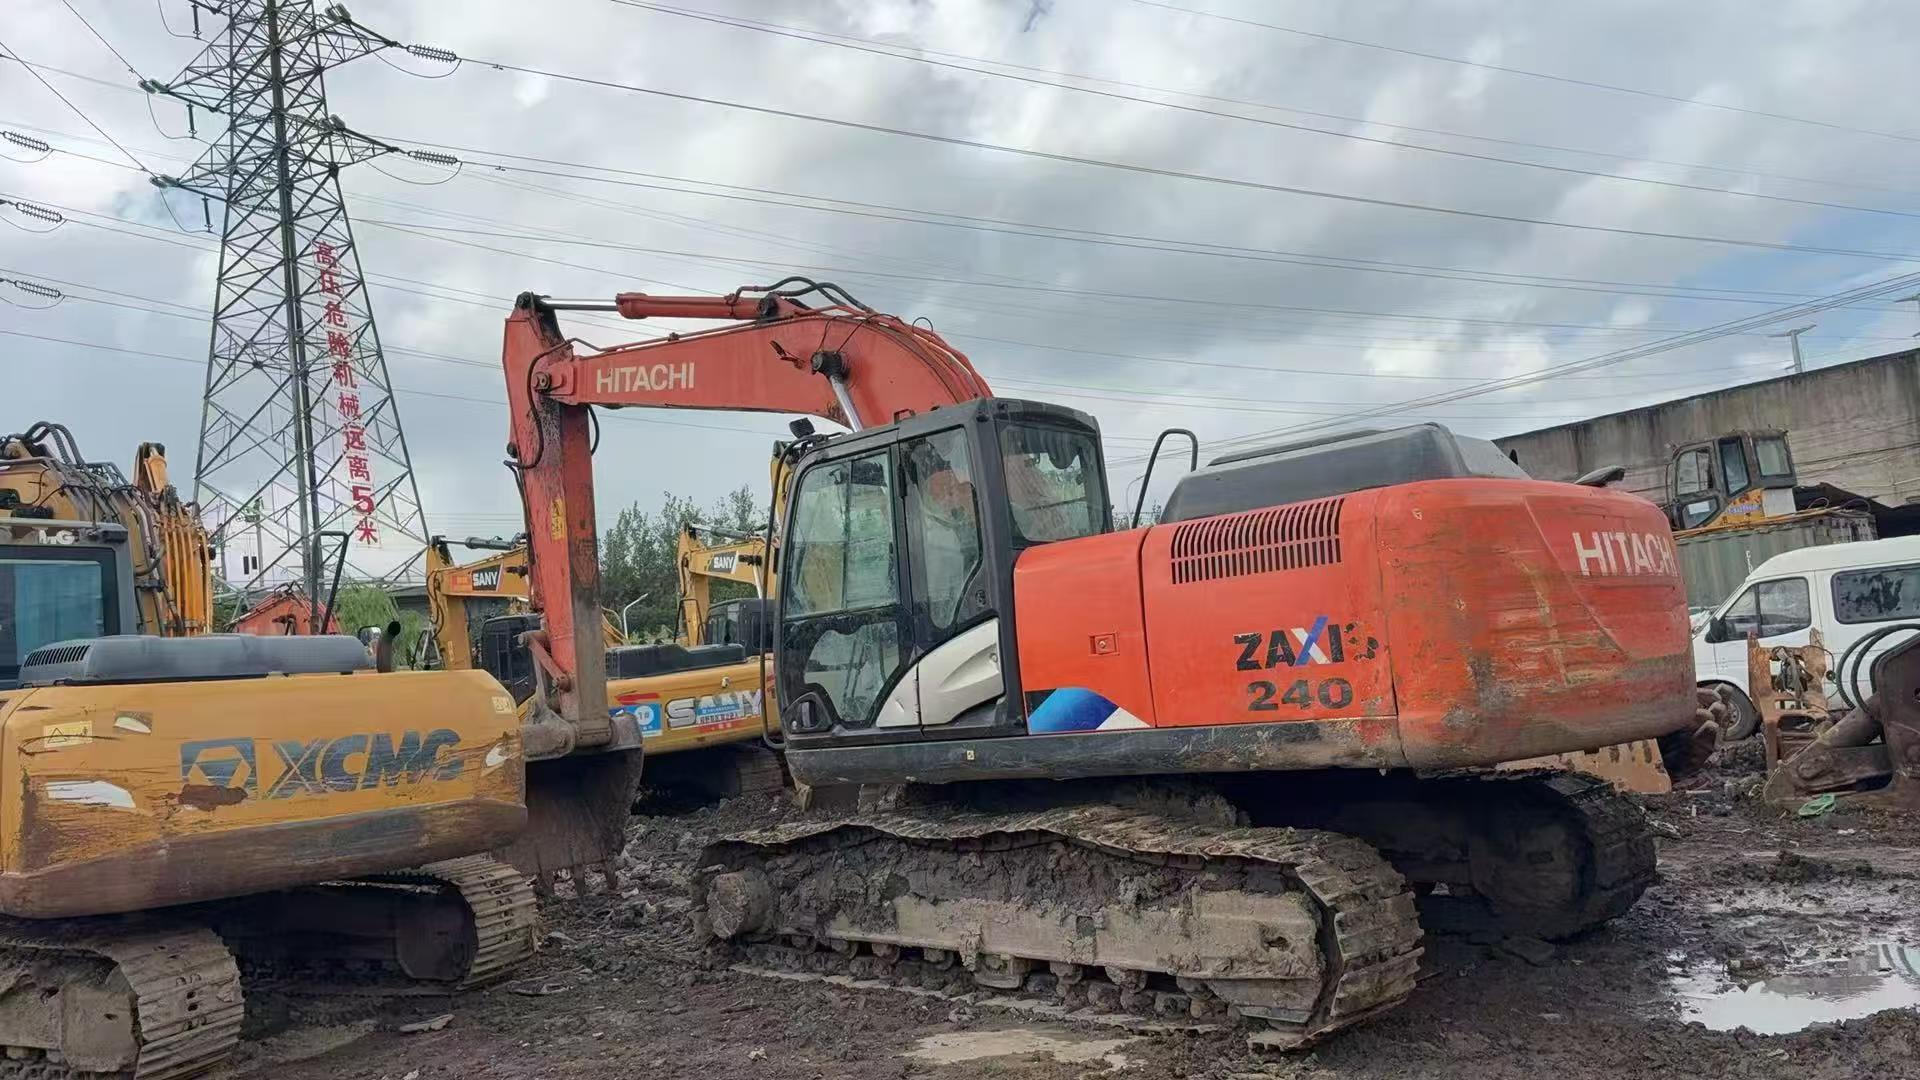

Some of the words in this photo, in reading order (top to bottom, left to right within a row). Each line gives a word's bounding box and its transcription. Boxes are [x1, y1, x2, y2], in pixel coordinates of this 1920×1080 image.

[596, 362, 695, 394] HITACHI
[712, 556, 735, 569] SANY
[472, 571, 498, 587] SANY
[1247, 677, 1354, 712] 240
[268, 729, 466, 801] XCMG
